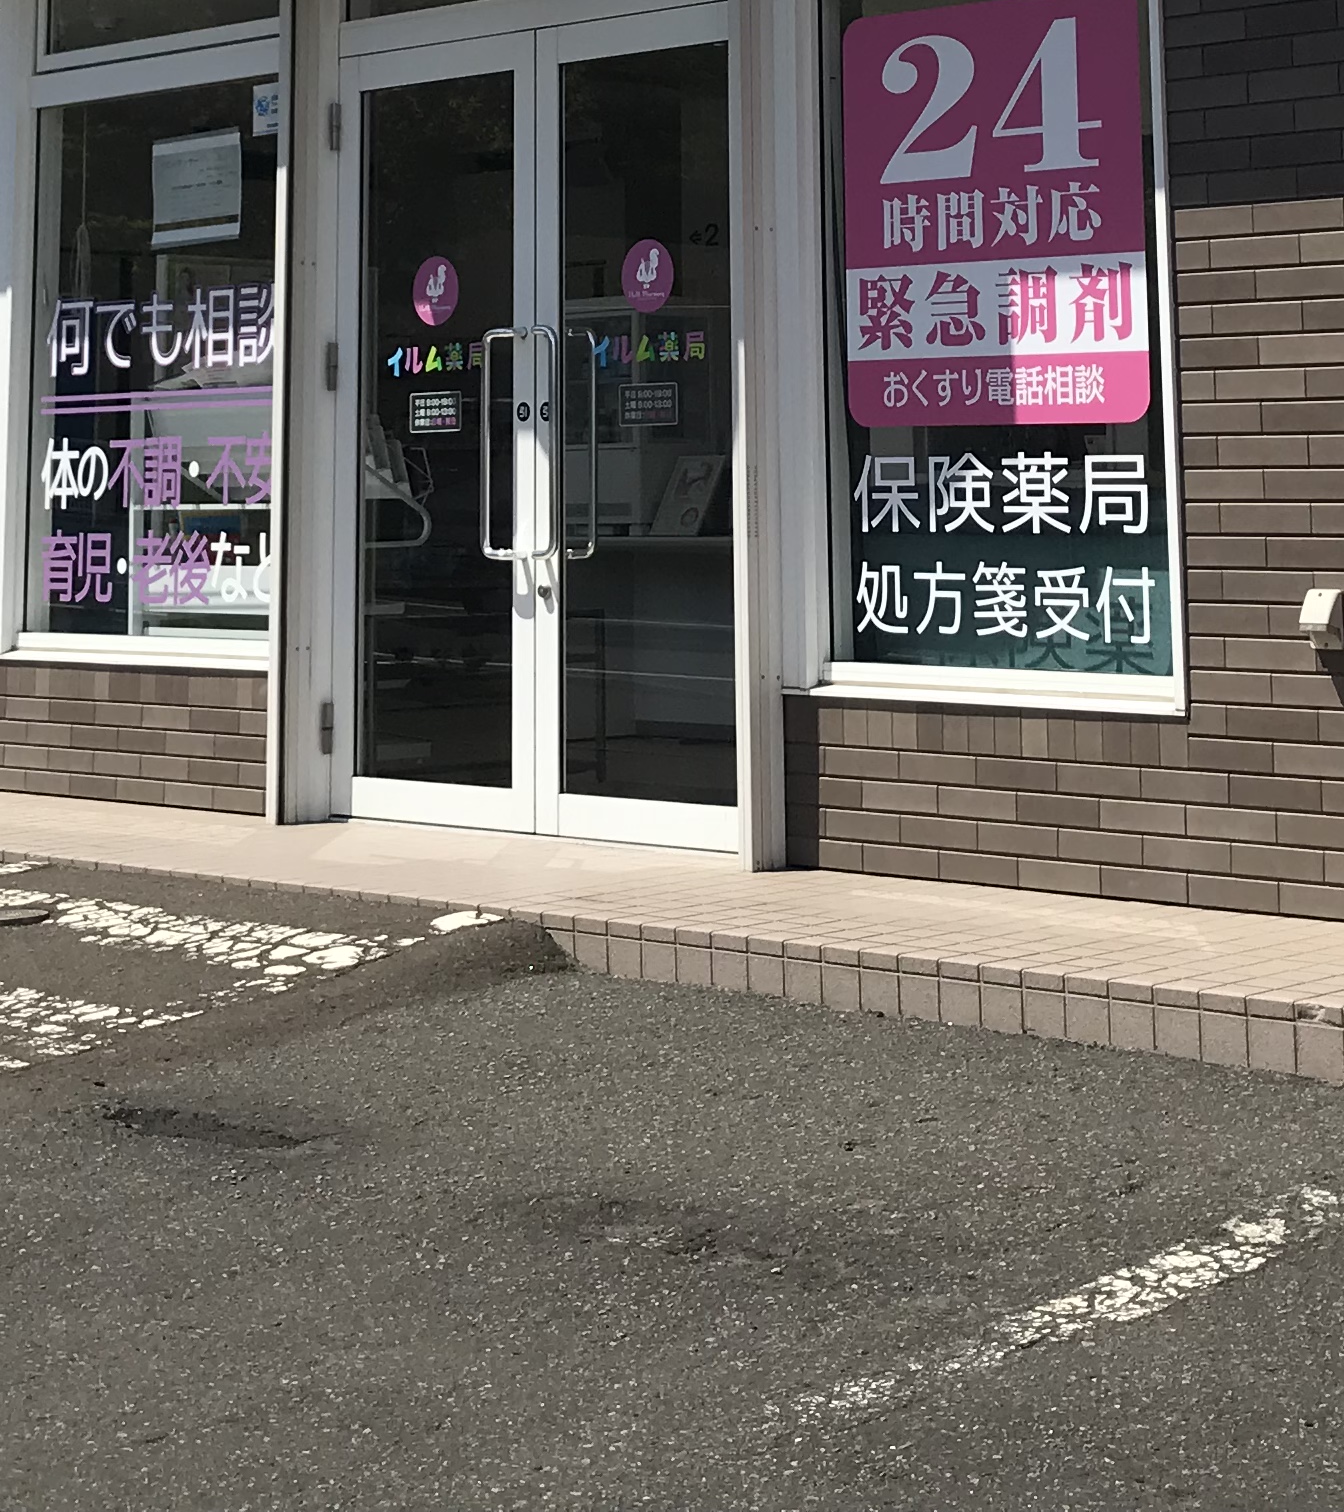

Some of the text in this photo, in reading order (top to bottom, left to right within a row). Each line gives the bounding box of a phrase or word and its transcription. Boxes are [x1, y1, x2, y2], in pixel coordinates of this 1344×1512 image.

[879, 17, 1102, 184] 24
[882, 182, 1102, 252] 時間対応
[47, 286, 274, 377] 何でも相談
[857, 261, 1133, 350] 緊急調剤
[387, 341, 483, 377] イルム薬局
[593, 331, 705, 368] イルム薬局
[882, 364, 1105, 407] おくすり電話相談
[41, 432, 272, 511] 体の不調・不安
[854, 451, 1149, 534] 保険薬局
[856, 561, 1155, 644] 処方箋受付
